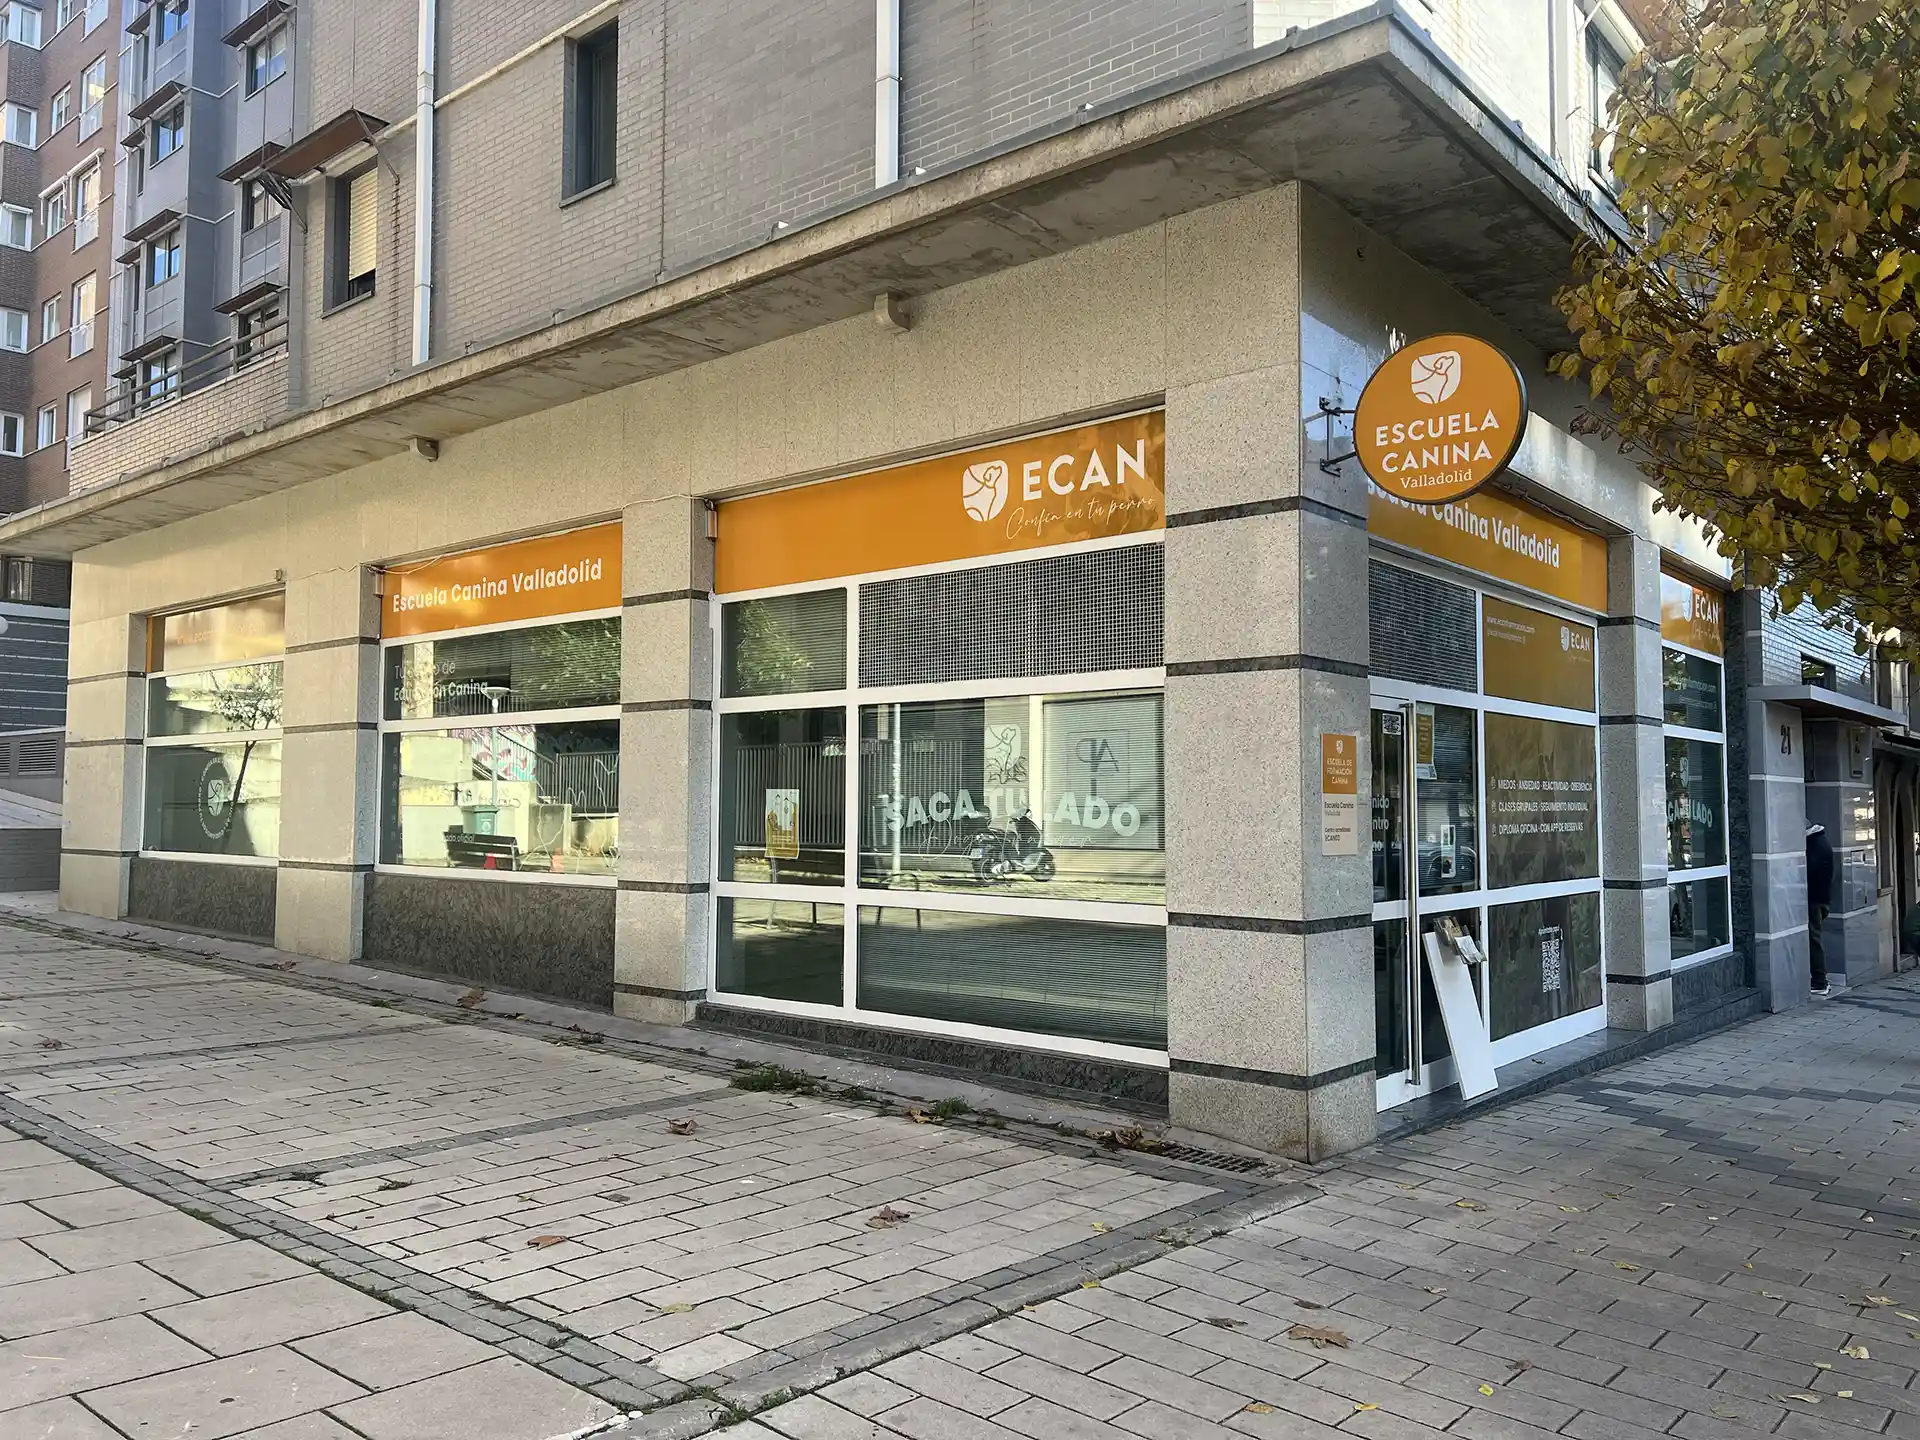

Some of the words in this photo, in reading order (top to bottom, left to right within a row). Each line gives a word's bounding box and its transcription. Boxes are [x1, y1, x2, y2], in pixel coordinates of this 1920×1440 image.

[1375, 409, 1500, 447] ESCUELA
[1022, 438, 1146, 501] ECAN
[1381, 440, 1493, 473] CANINA
[1400, 469, 1473, 489] Valladolid
[1066, 509, 1084, 520] en
[1087, 496, 1105, 520] tu
[1106, 496, 1154, 526] perro
[1492, 516, 1560, 569] Valladolid
[393, 586, 448, 613] Escuela
[451, 576, 508, 603] Canina
[511, 557, 602, 593] Valladolid
[1695, 593, 1719, 625] ECAN
[1570, 631, 1591, 652] ECAN
[448, 678, 489, 697] Canina
[1780, 724, 1792, 755] 21
[884, 789, 977, 832] SACA
[1371, 793, 1390, 809] nido
